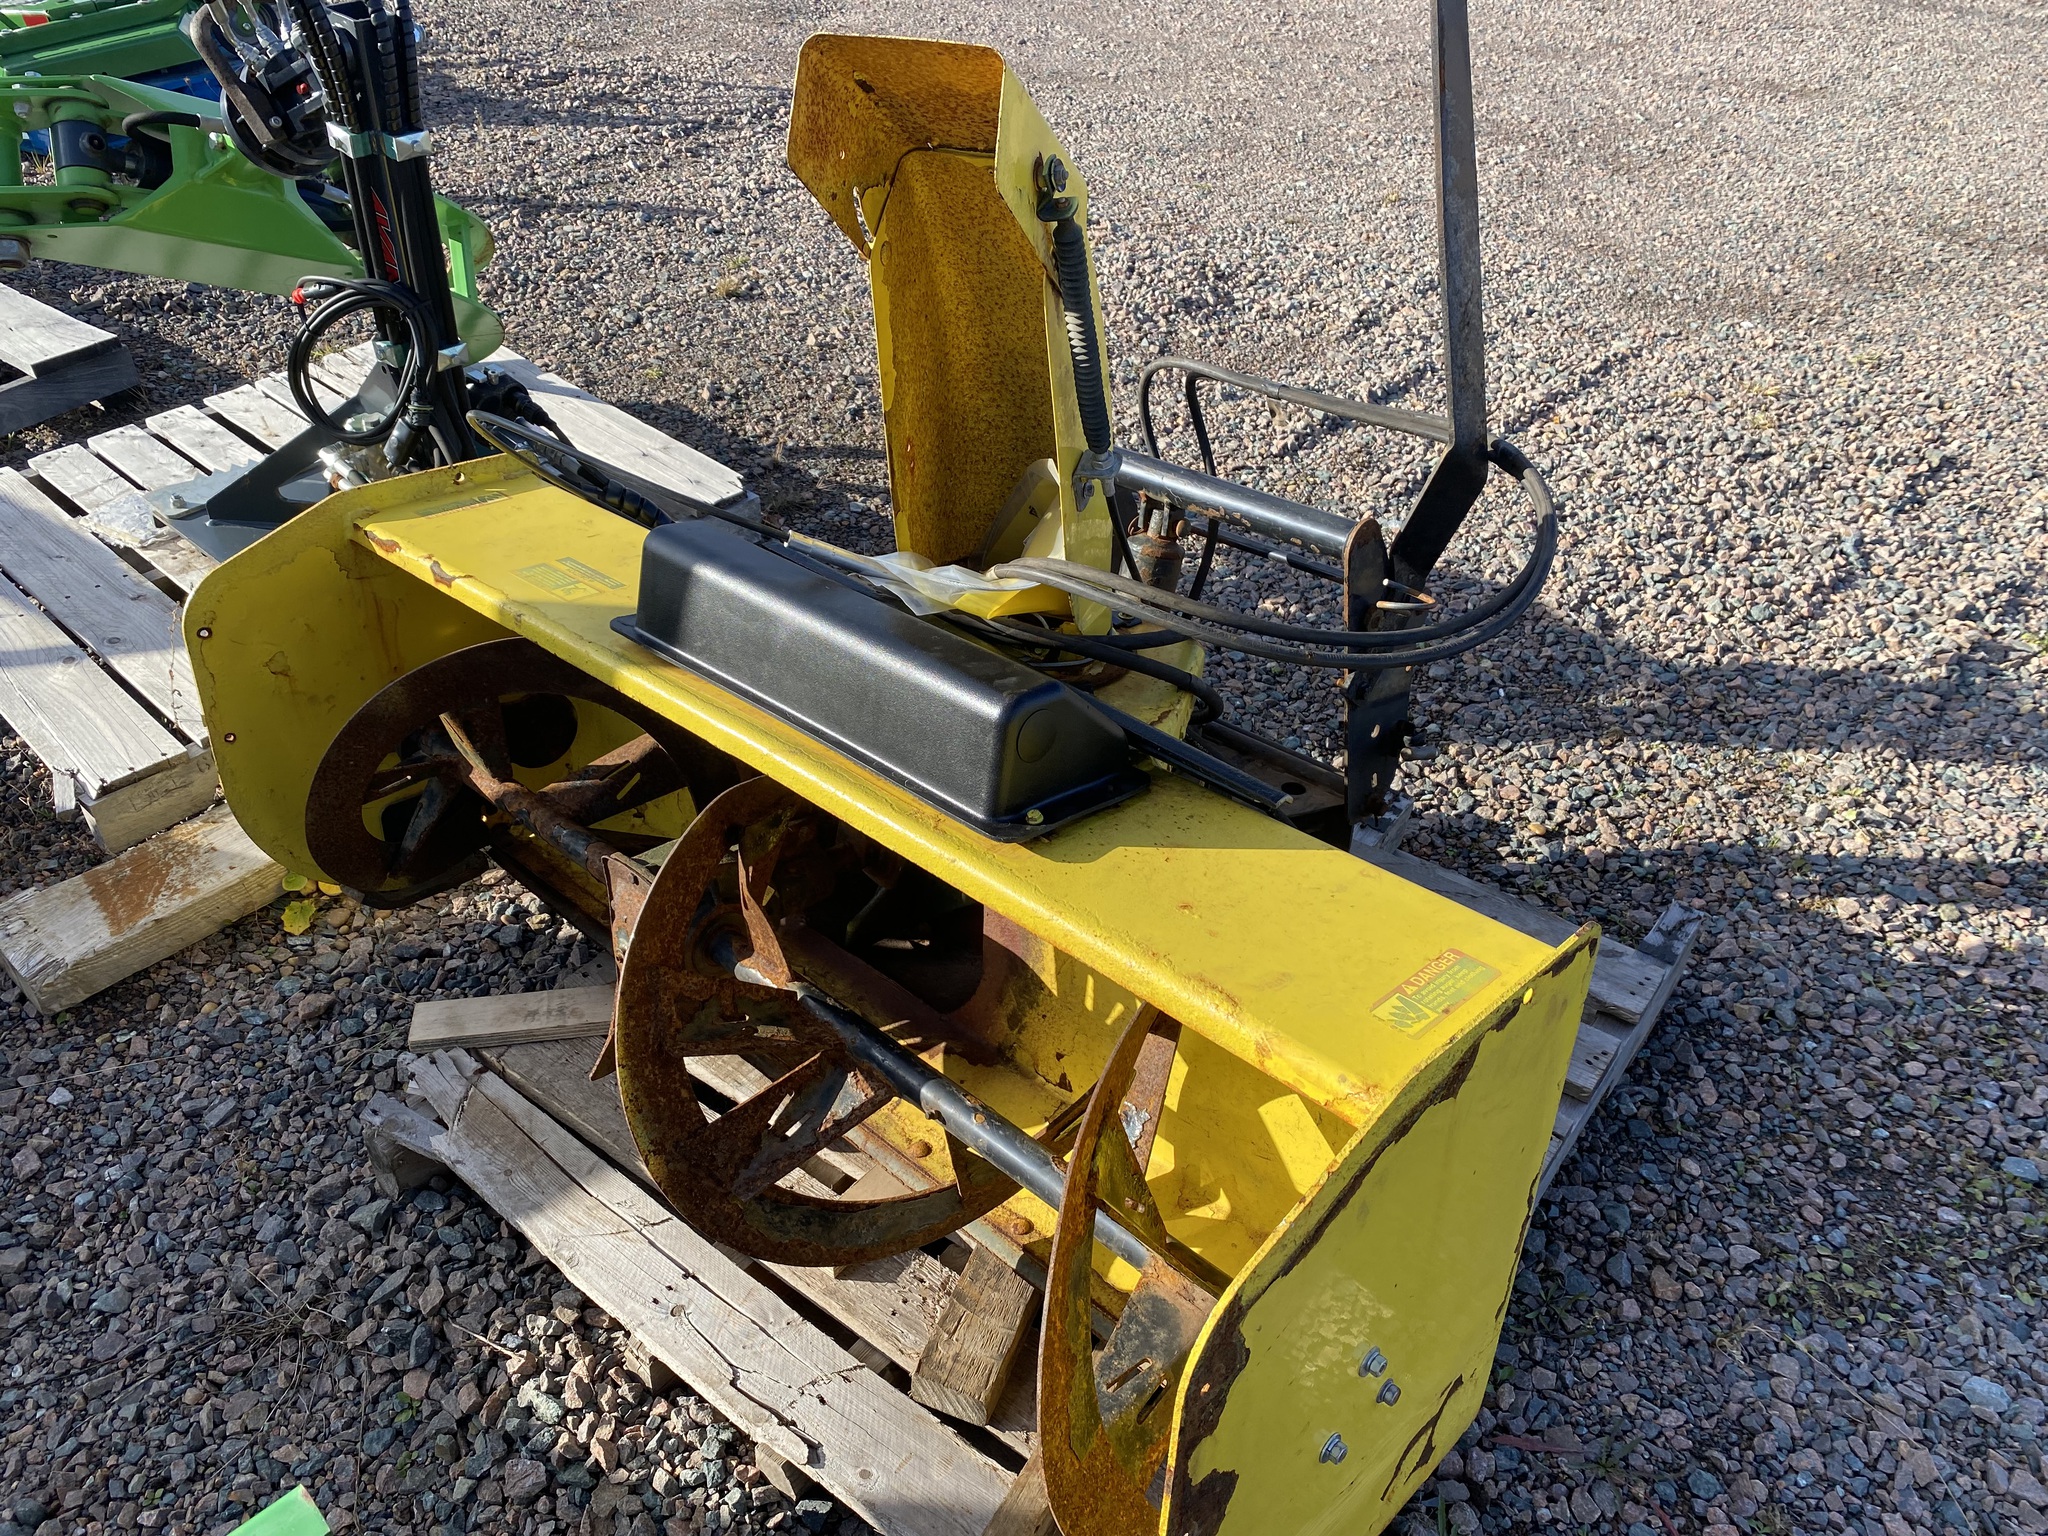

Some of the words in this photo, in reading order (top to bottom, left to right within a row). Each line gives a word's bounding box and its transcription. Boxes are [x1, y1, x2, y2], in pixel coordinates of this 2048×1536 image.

[1409, 951, 1460, 986] DANGER
[1421, 983, 1436, 996] avoid
[1434, 973, 1451, 985] injury
[1446, 964, 1461, 975] from
